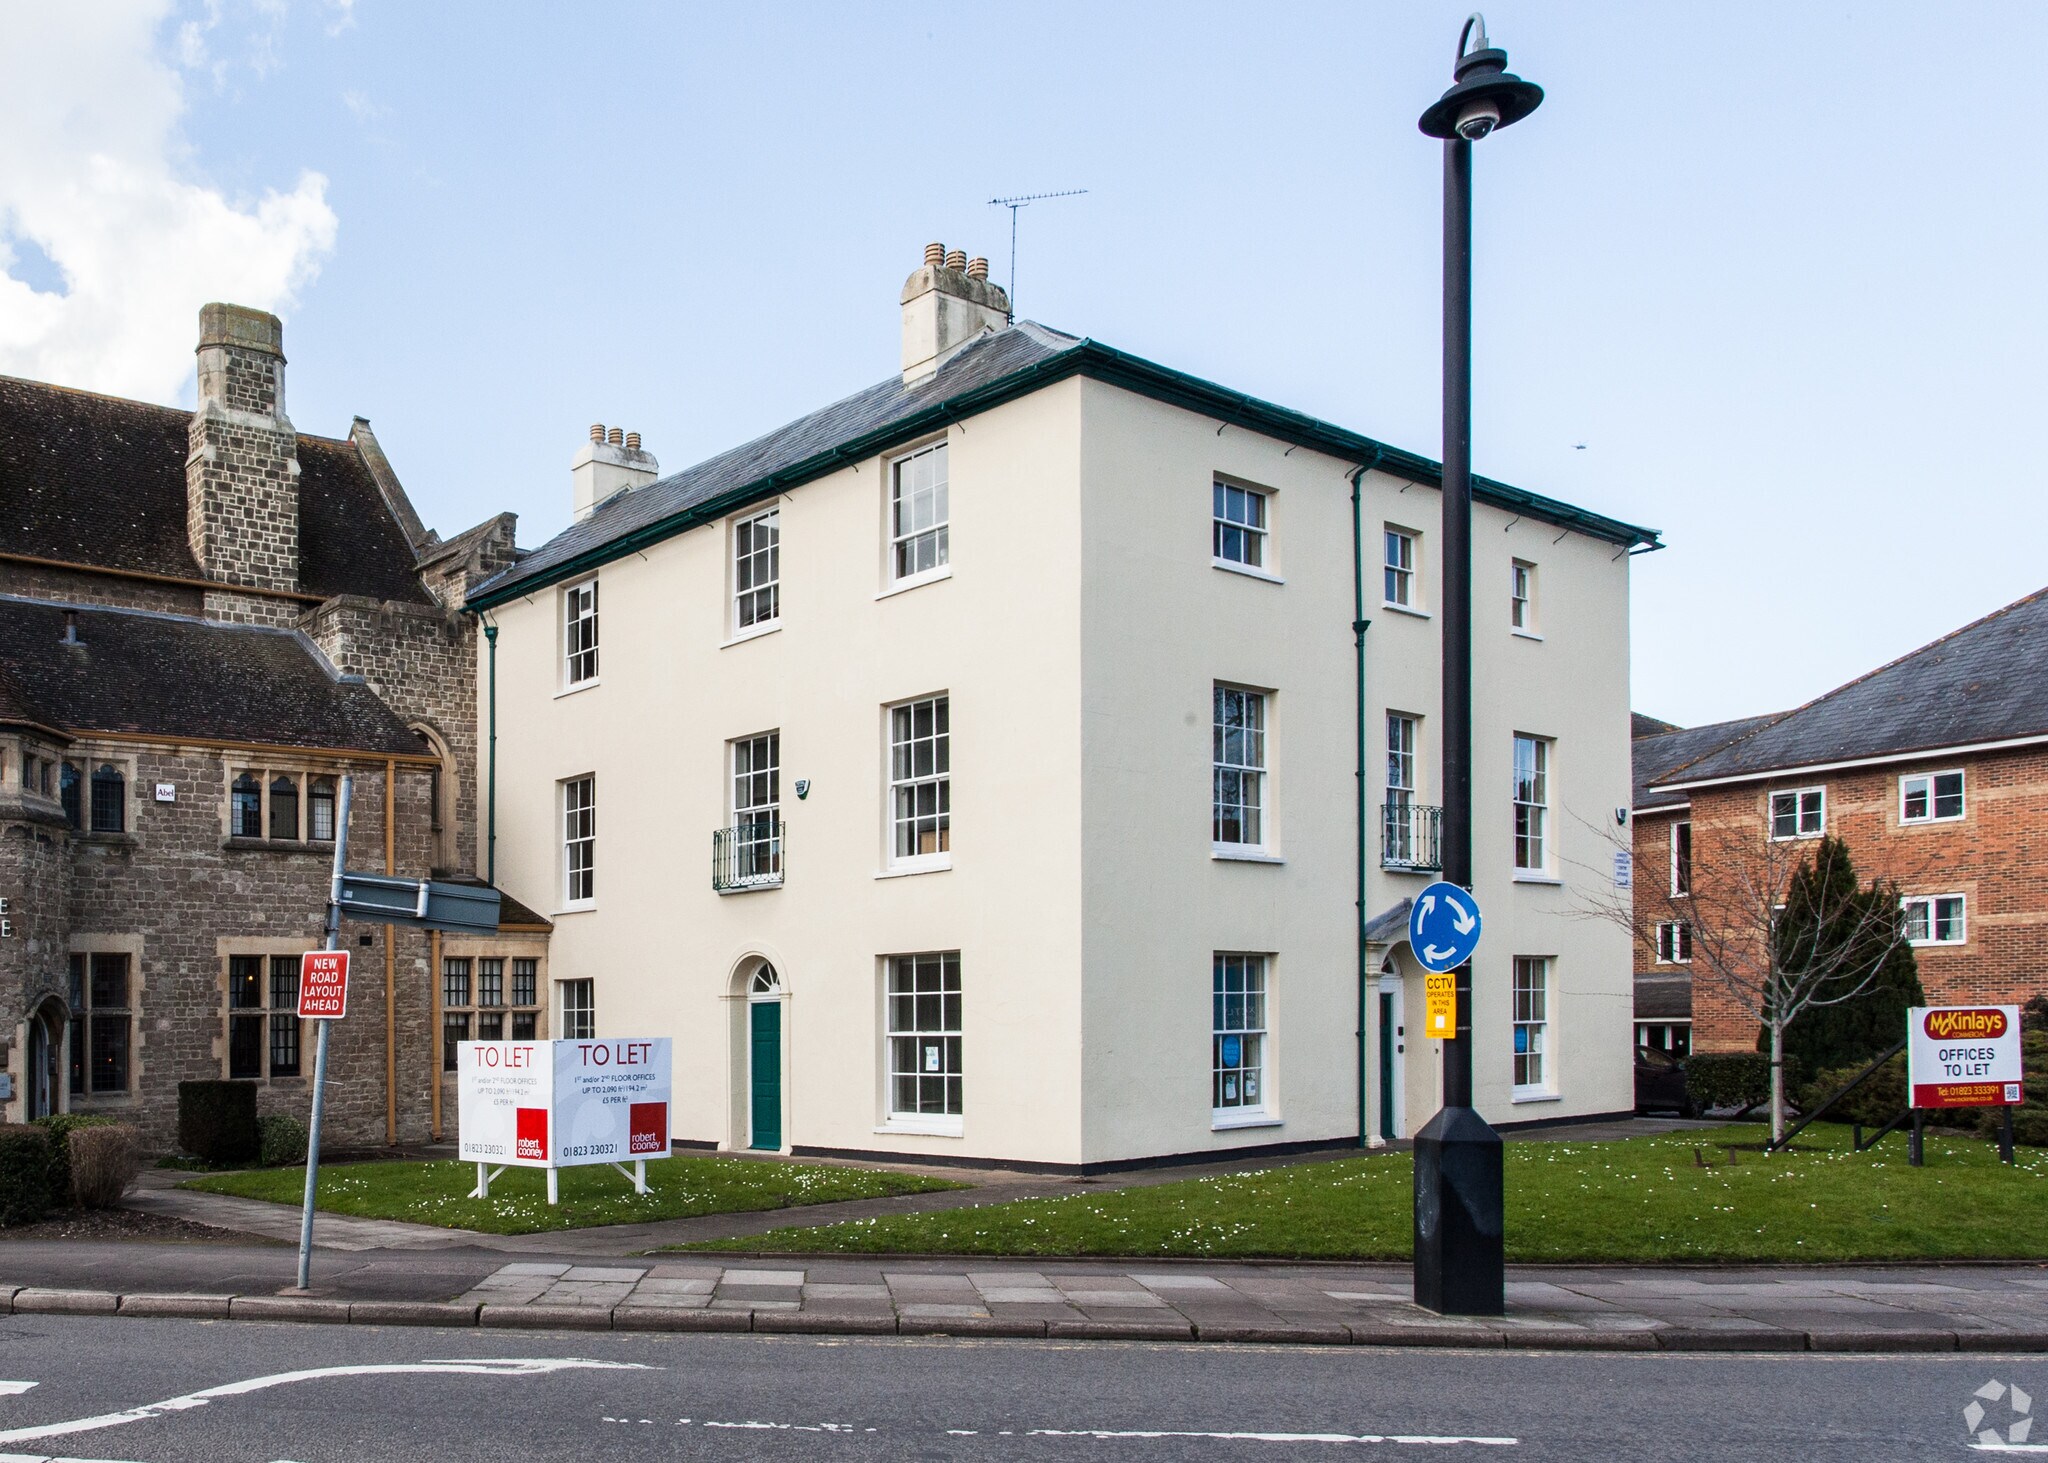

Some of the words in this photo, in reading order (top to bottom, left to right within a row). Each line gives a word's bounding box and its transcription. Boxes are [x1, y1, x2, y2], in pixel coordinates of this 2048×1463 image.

[158, 788, 174, 797] Abel
[314, 959, 338, 969] NEW
[310, 972, 338, 983] ROAD
[1427, 978, 1453, 989] CCTV
[304, 986, 342, 997] LAYOUT
[304, 1000, 339, 1011] AHEAD
[1930, 1011, 2002, 1036] McKinlays
[475, 1047, 499, 1067] TO
[504, 1047, 534, 1068] LET
[578, 1045, 609, 1066] TO
[617, 1043, 652, 1064] LET
[1939, 1048, 1995, 1061] OFFICES
[1944, 1064, 1962, 1076] TO
[1966, 1064, 1990, 1076] LET
[1950, 1087, 1972, 1095] 01823
[1974, 1086, 1999, 1094] 333391
[518, 1138, 539, 1149] robert
[632, 1133, 656, 1143] robert
[464, 1142, 482, 1153] 01823
[485, 1144, 507, 1155] 230321
[563, 1146, 588, 1157] 01823
[590, 1143, 618, 1156] 230321
[632, 1141, 661, 1152] cooney
[518, 1148, 543, 1159] cooney
